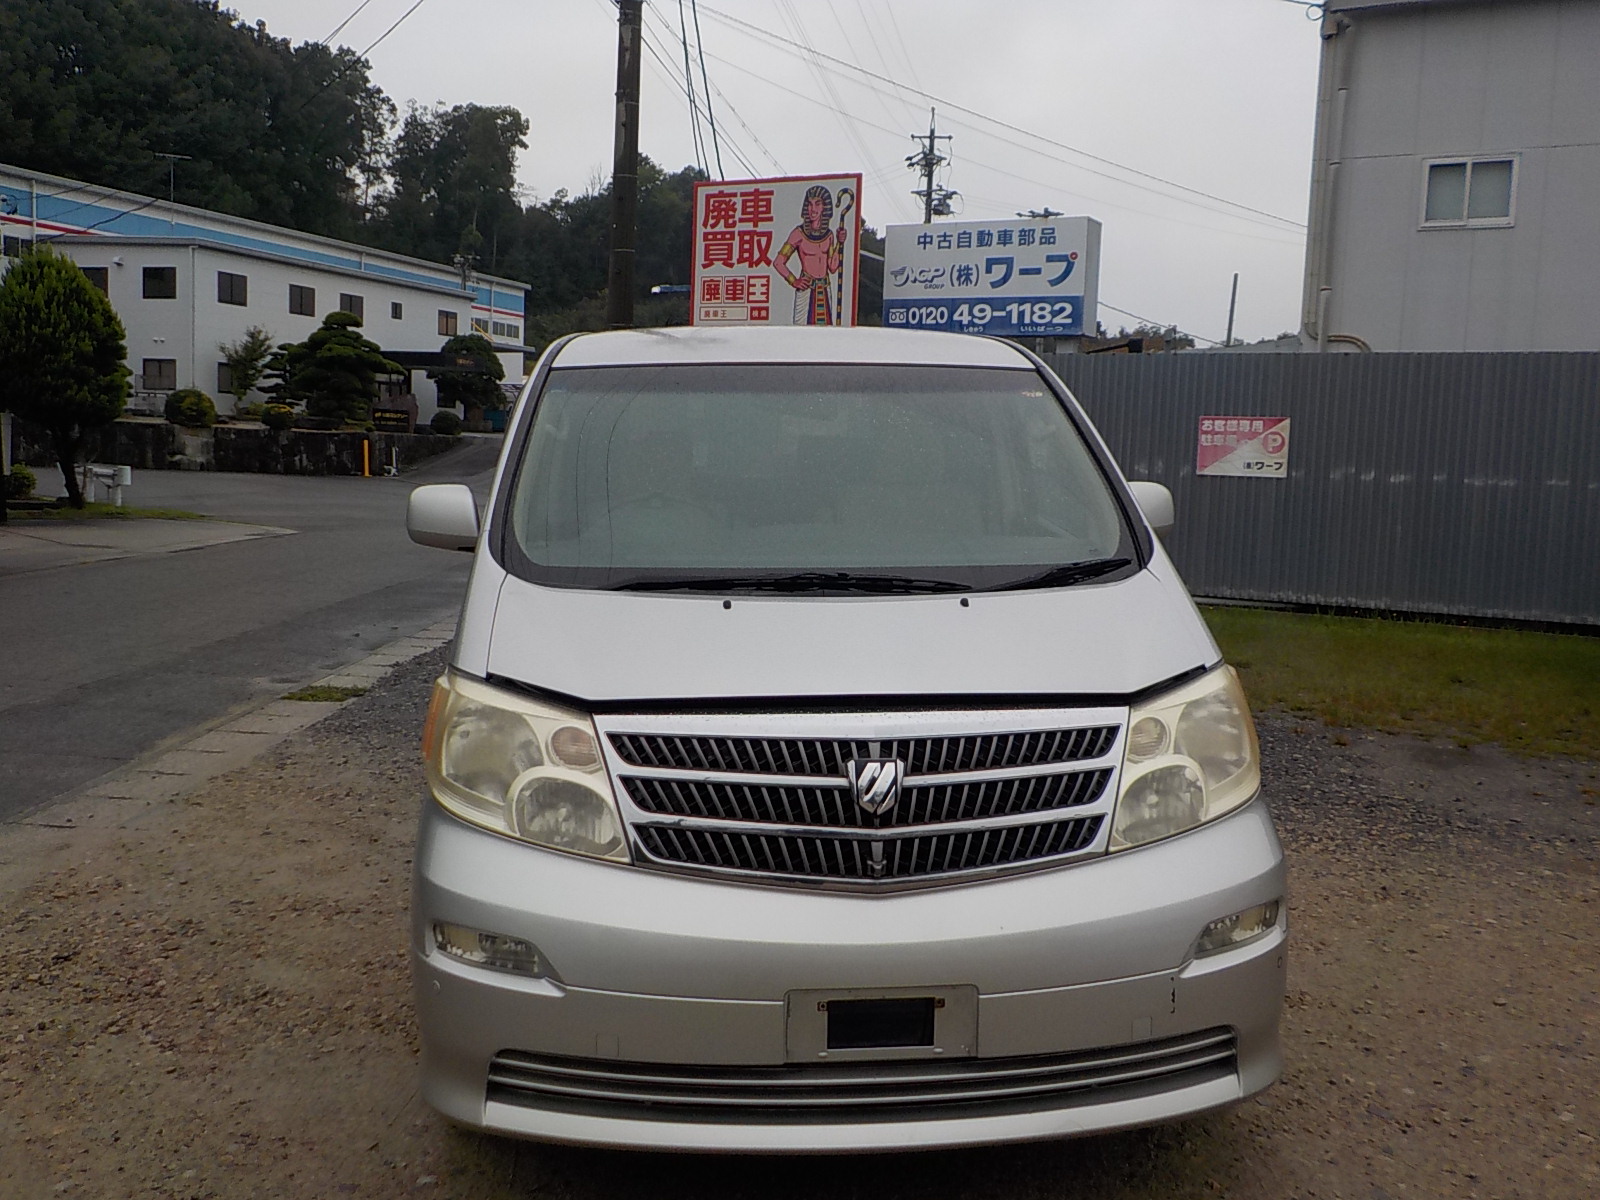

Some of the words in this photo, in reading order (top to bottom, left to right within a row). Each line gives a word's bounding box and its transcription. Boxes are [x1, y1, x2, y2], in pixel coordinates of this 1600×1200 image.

[702, 188, 774, 229] 廃車
[701, 230, 773, 269] 買取
[917, 227, 1056, 250] 中古自動車部品
[908, 306, 948, 324] 0120
[952, 302, 1073, 325] 49-1182
